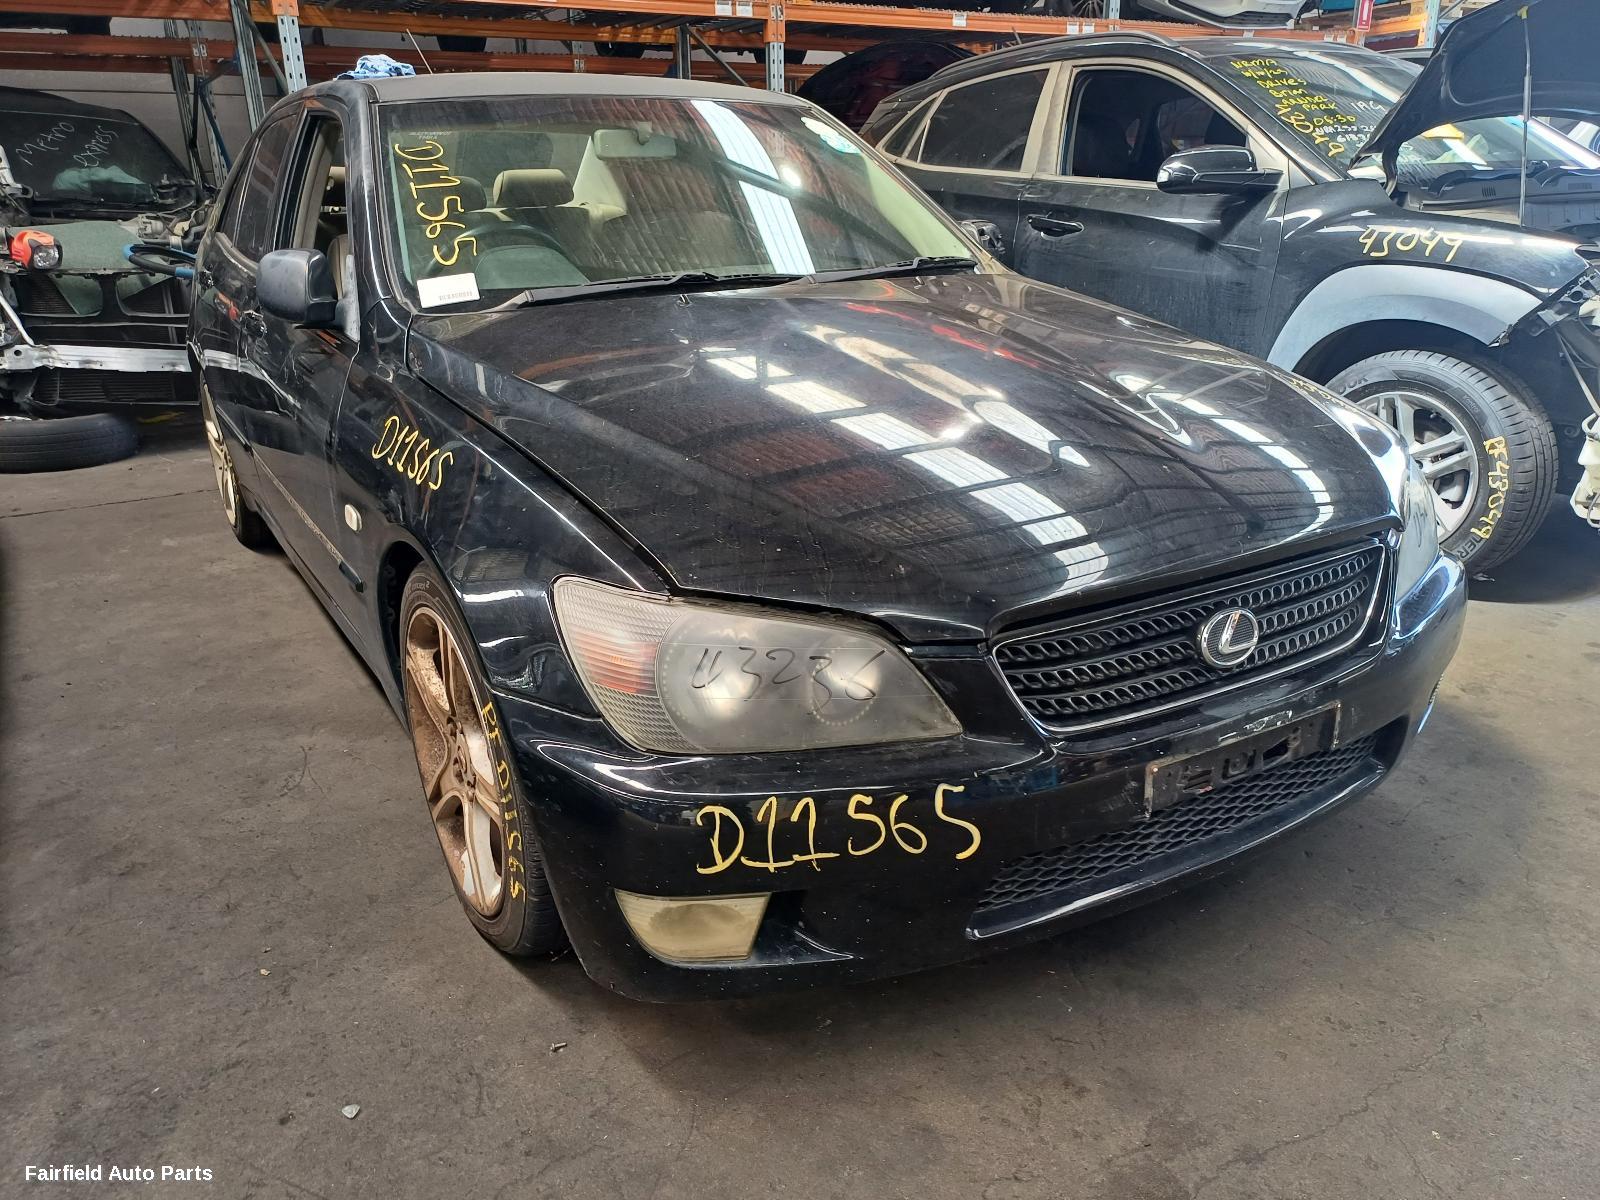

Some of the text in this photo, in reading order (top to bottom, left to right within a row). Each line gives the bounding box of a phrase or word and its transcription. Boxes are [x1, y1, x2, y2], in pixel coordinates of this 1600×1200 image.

[394, 140, 477, 266] D11565
[372, 415, 454, 490] D11565
[696, 783, 982, 874] D11565
